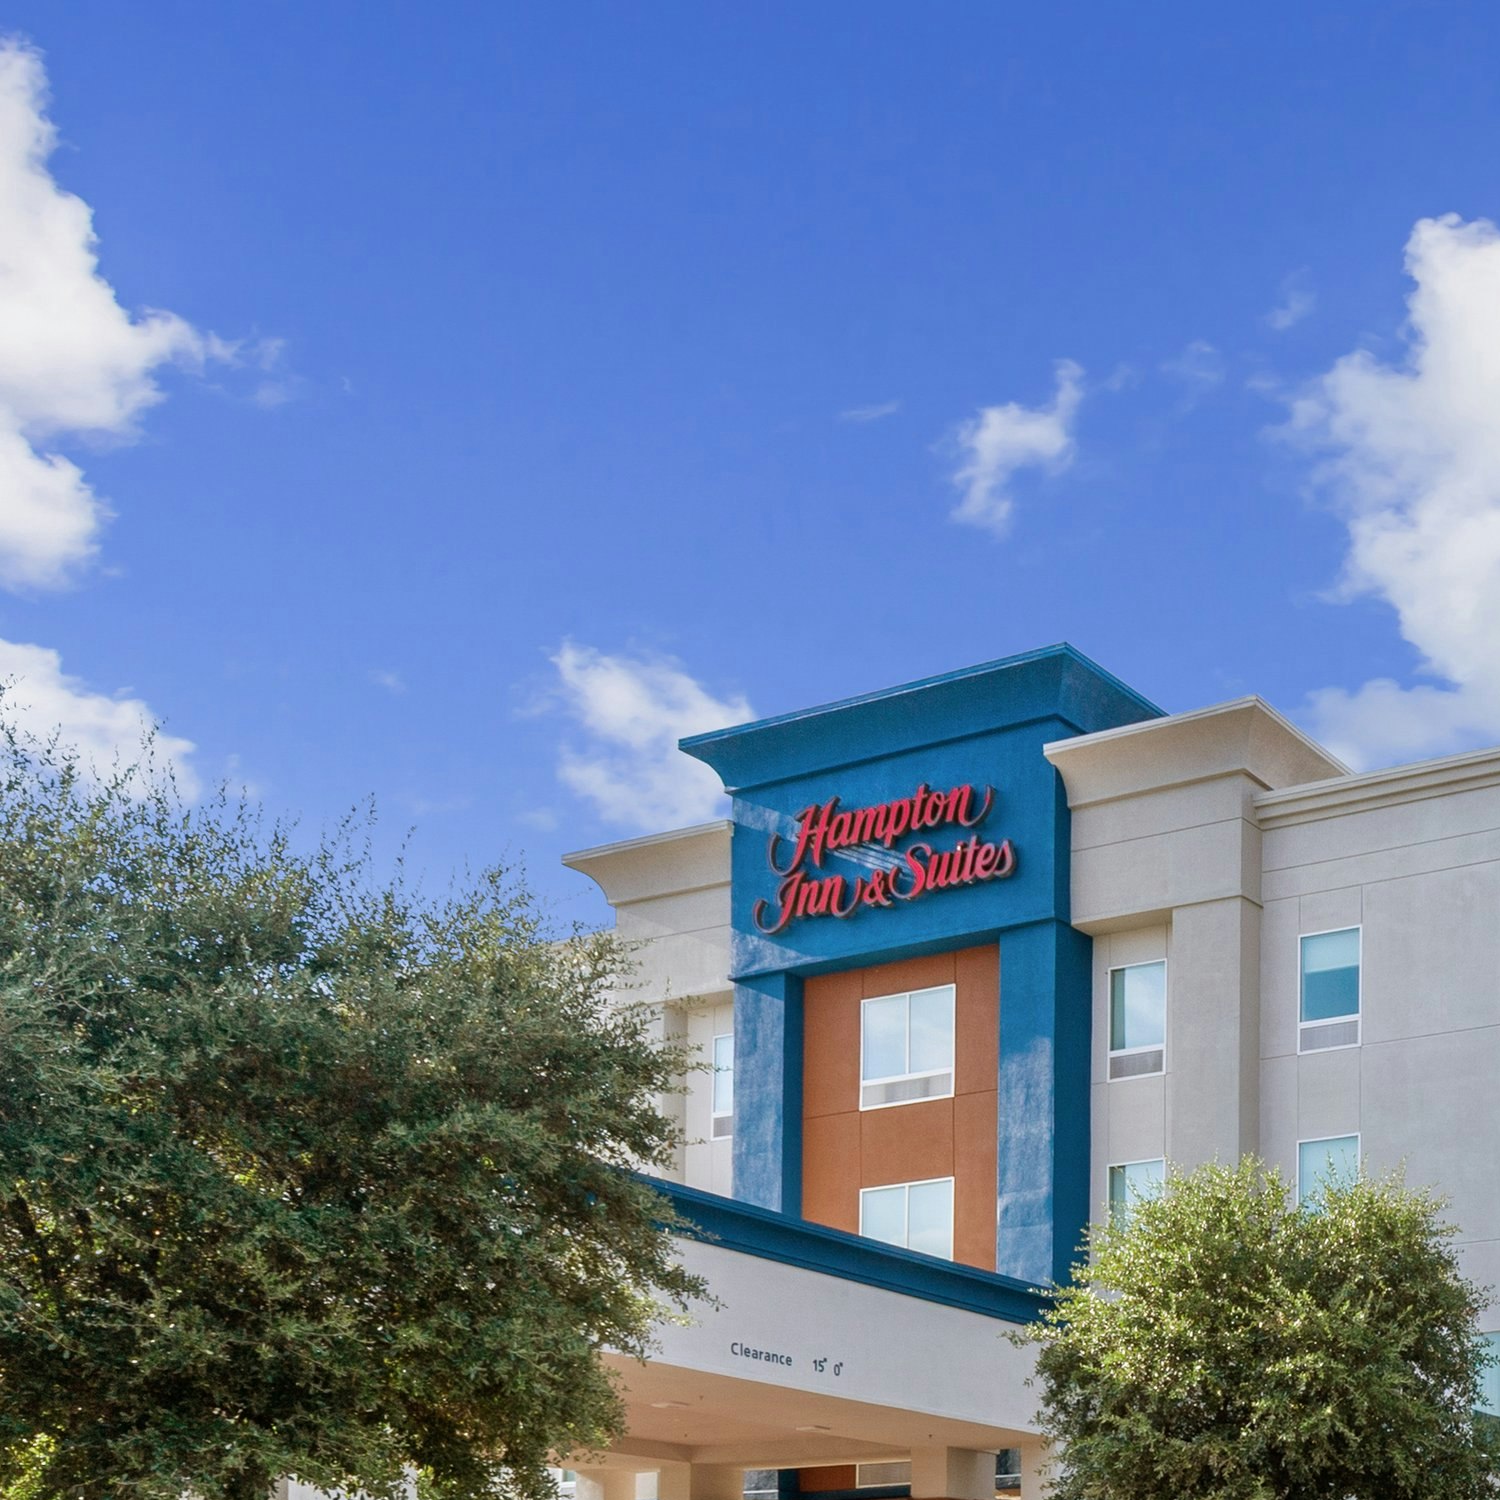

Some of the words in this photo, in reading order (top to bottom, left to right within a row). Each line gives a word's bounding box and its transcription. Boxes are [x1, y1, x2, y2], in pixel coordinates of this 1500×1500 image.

[769, 784, 993, 875] Hampton
[753, 872, 864, 935] Inn
[864, 871, 892, 906] &
[889, 835, 1016, 900] Suites
[730, 1342, 793, 1366] Clearance
